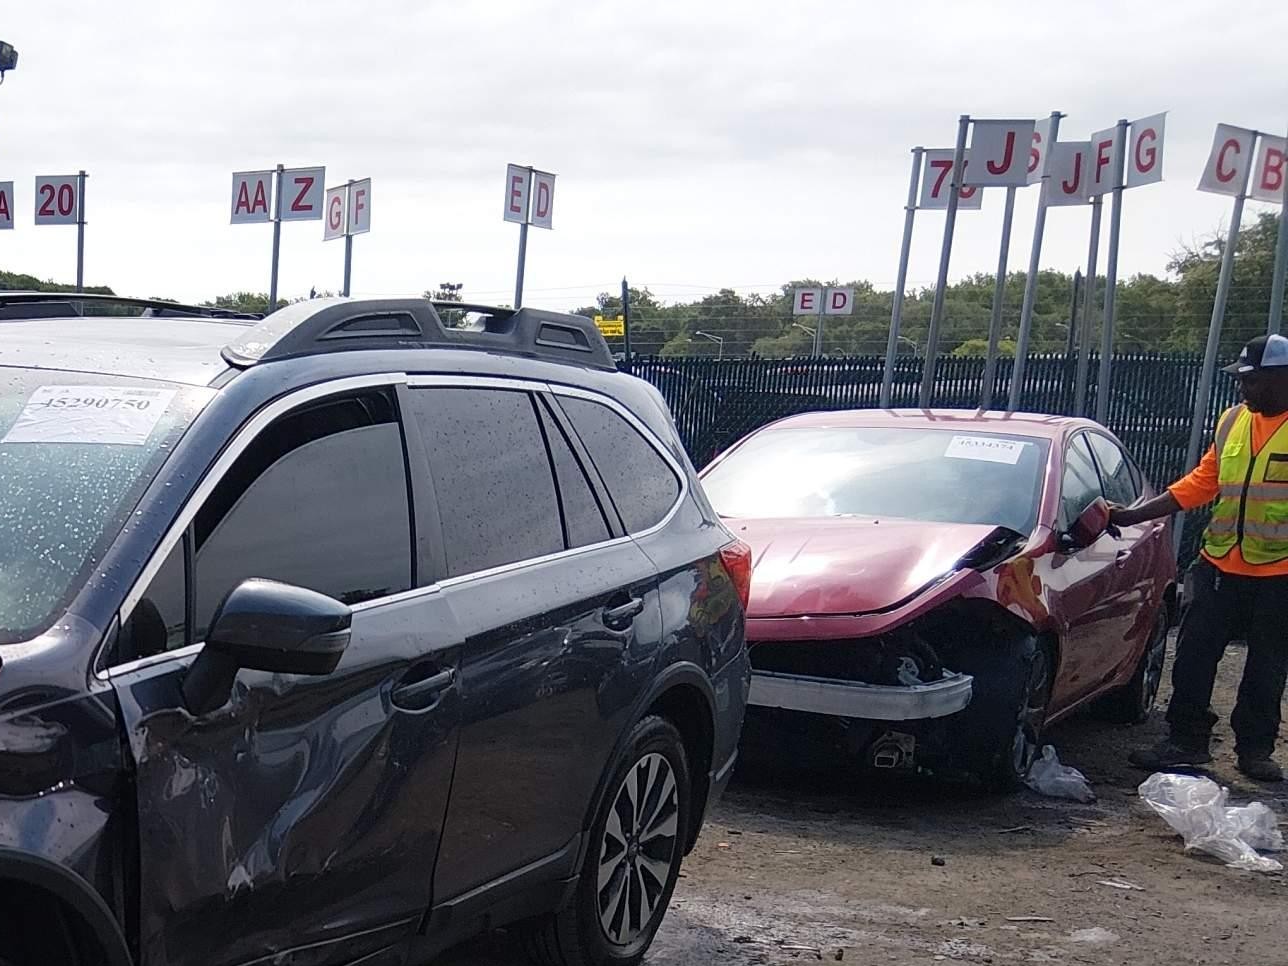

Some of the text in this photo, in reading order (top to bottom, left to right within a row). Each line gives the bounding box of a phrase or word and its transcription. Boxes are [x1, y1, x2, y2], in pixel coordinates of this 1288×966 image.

[987, 132, 1015, 175] J
[1096, 140, 1113, 183] F
[1135, 128, 1157, 173] G
[1216, 139, 1240, 182] C
[1062, 153, 1082, 194] J
[1260, 147, 1284, 191] B
[39, 184, 74, 216] 20
[235, 180, 267, 214] AA
[291, 177, 314, 211] Z
[355, 190, 365, 224] F
[510, 176, 523, 213] E
[537, 182, 549, 217] D
[329, 196, 341, 230] G
[800, 293, 814, 309] E
[832, 293, 846, 309] D
